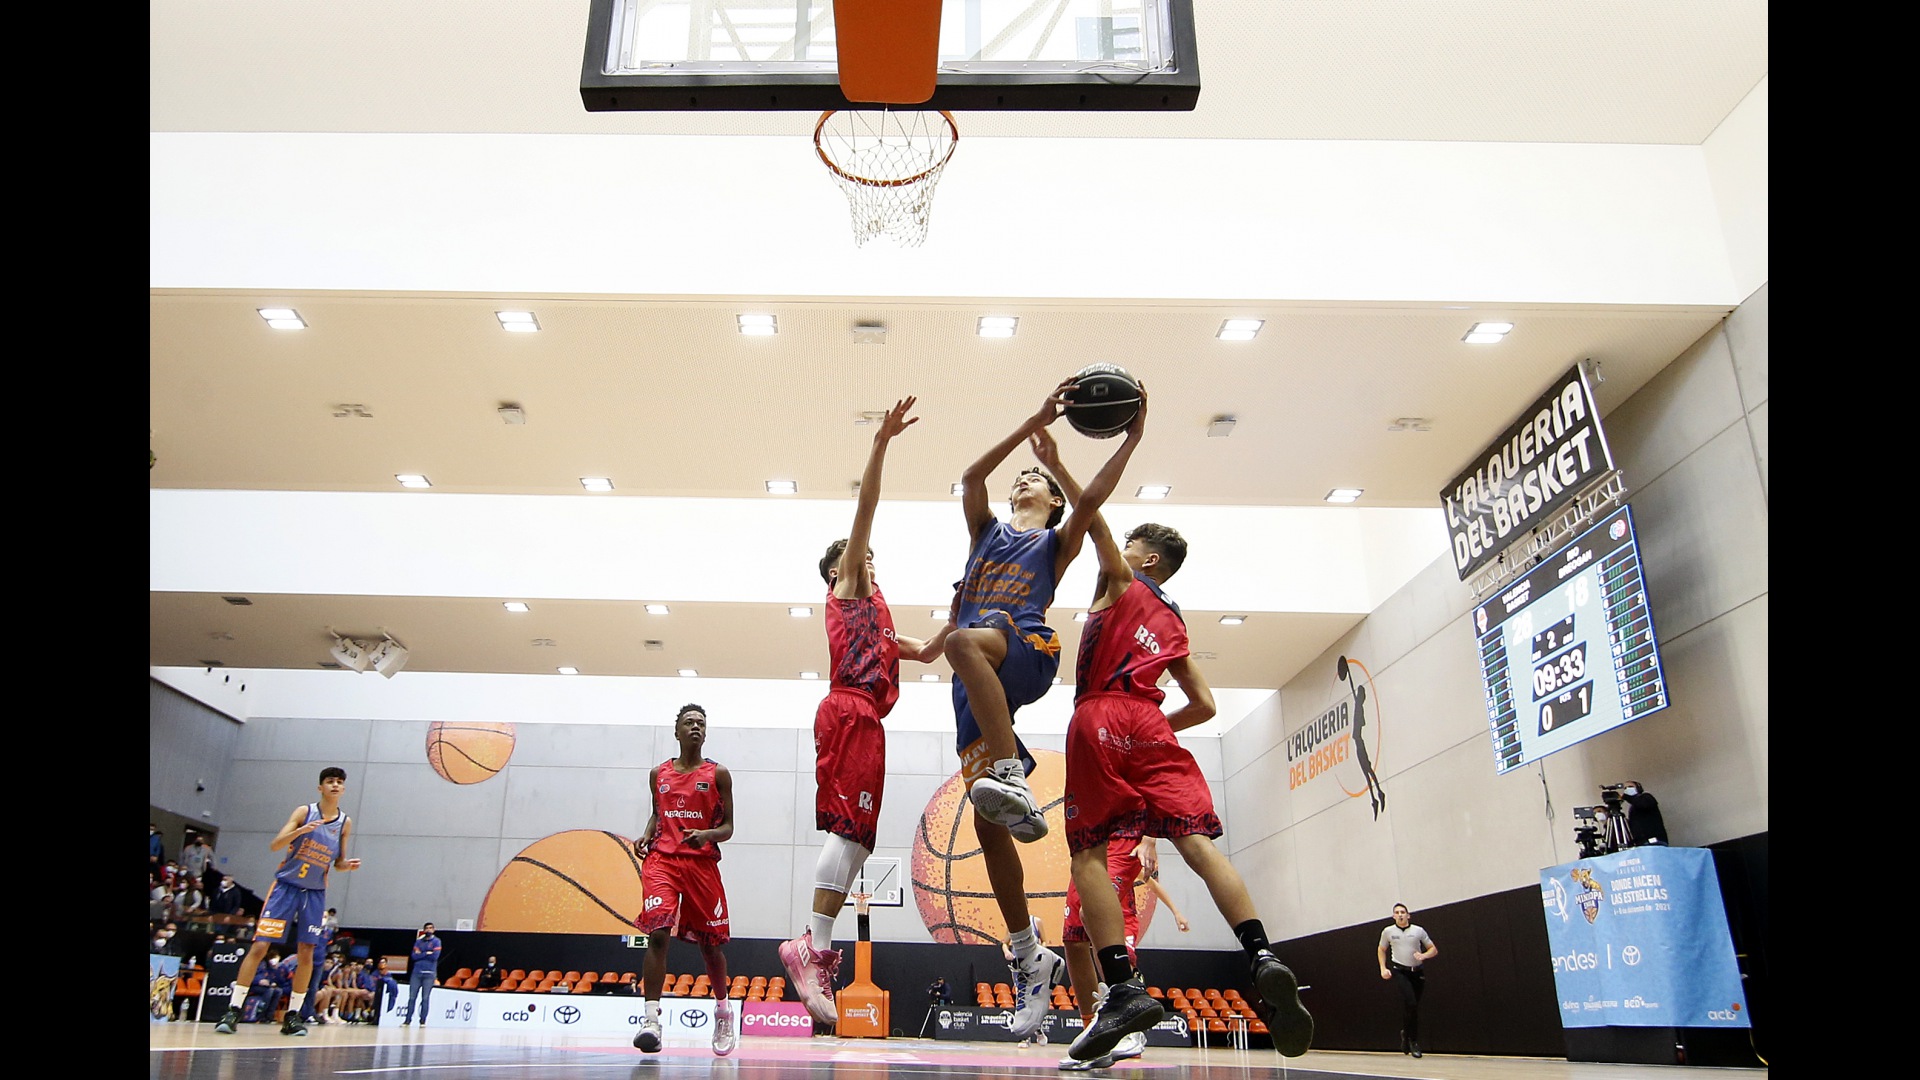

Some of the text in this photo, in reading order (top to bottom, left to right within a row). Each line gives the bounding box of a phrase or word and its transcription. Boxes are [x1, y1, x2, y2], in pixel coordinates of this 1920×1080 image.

[1446, 380, 1586, 529] L'ALQUERIA
[1454, 425, 1591, 570] DEL BASKET
[1564, 576, 1589, 612] 18
[1134, 624, 1160, 654] Río
[1546, 631, 1557, 649] 2
[1533, 649, 1585, 697] 09:33
[1542, 687, 1588, 731] 0 1
[1287, 702, 1349, 762] L'ALQUERIA
[962, 741, 989, 767] ULEV
[1289, 732, 1351, 791] DEL BASKET
[298, 863, 310, 879] 5
[1610, 892, 1623, 905] LAS
[1622, 888, 1668, 904] ESTRELLAS
[213, 952, 238, 963] acb
[1551, 949, 1598, 973] endes
[208, 985, 233, 997] acb
[502, 1010, 530, 1022] acb
[628, 1015, 645, 1025] ac
[744, 1011, 812, 1027] endesa
[1708, 1009, 1737, 1021] acb
